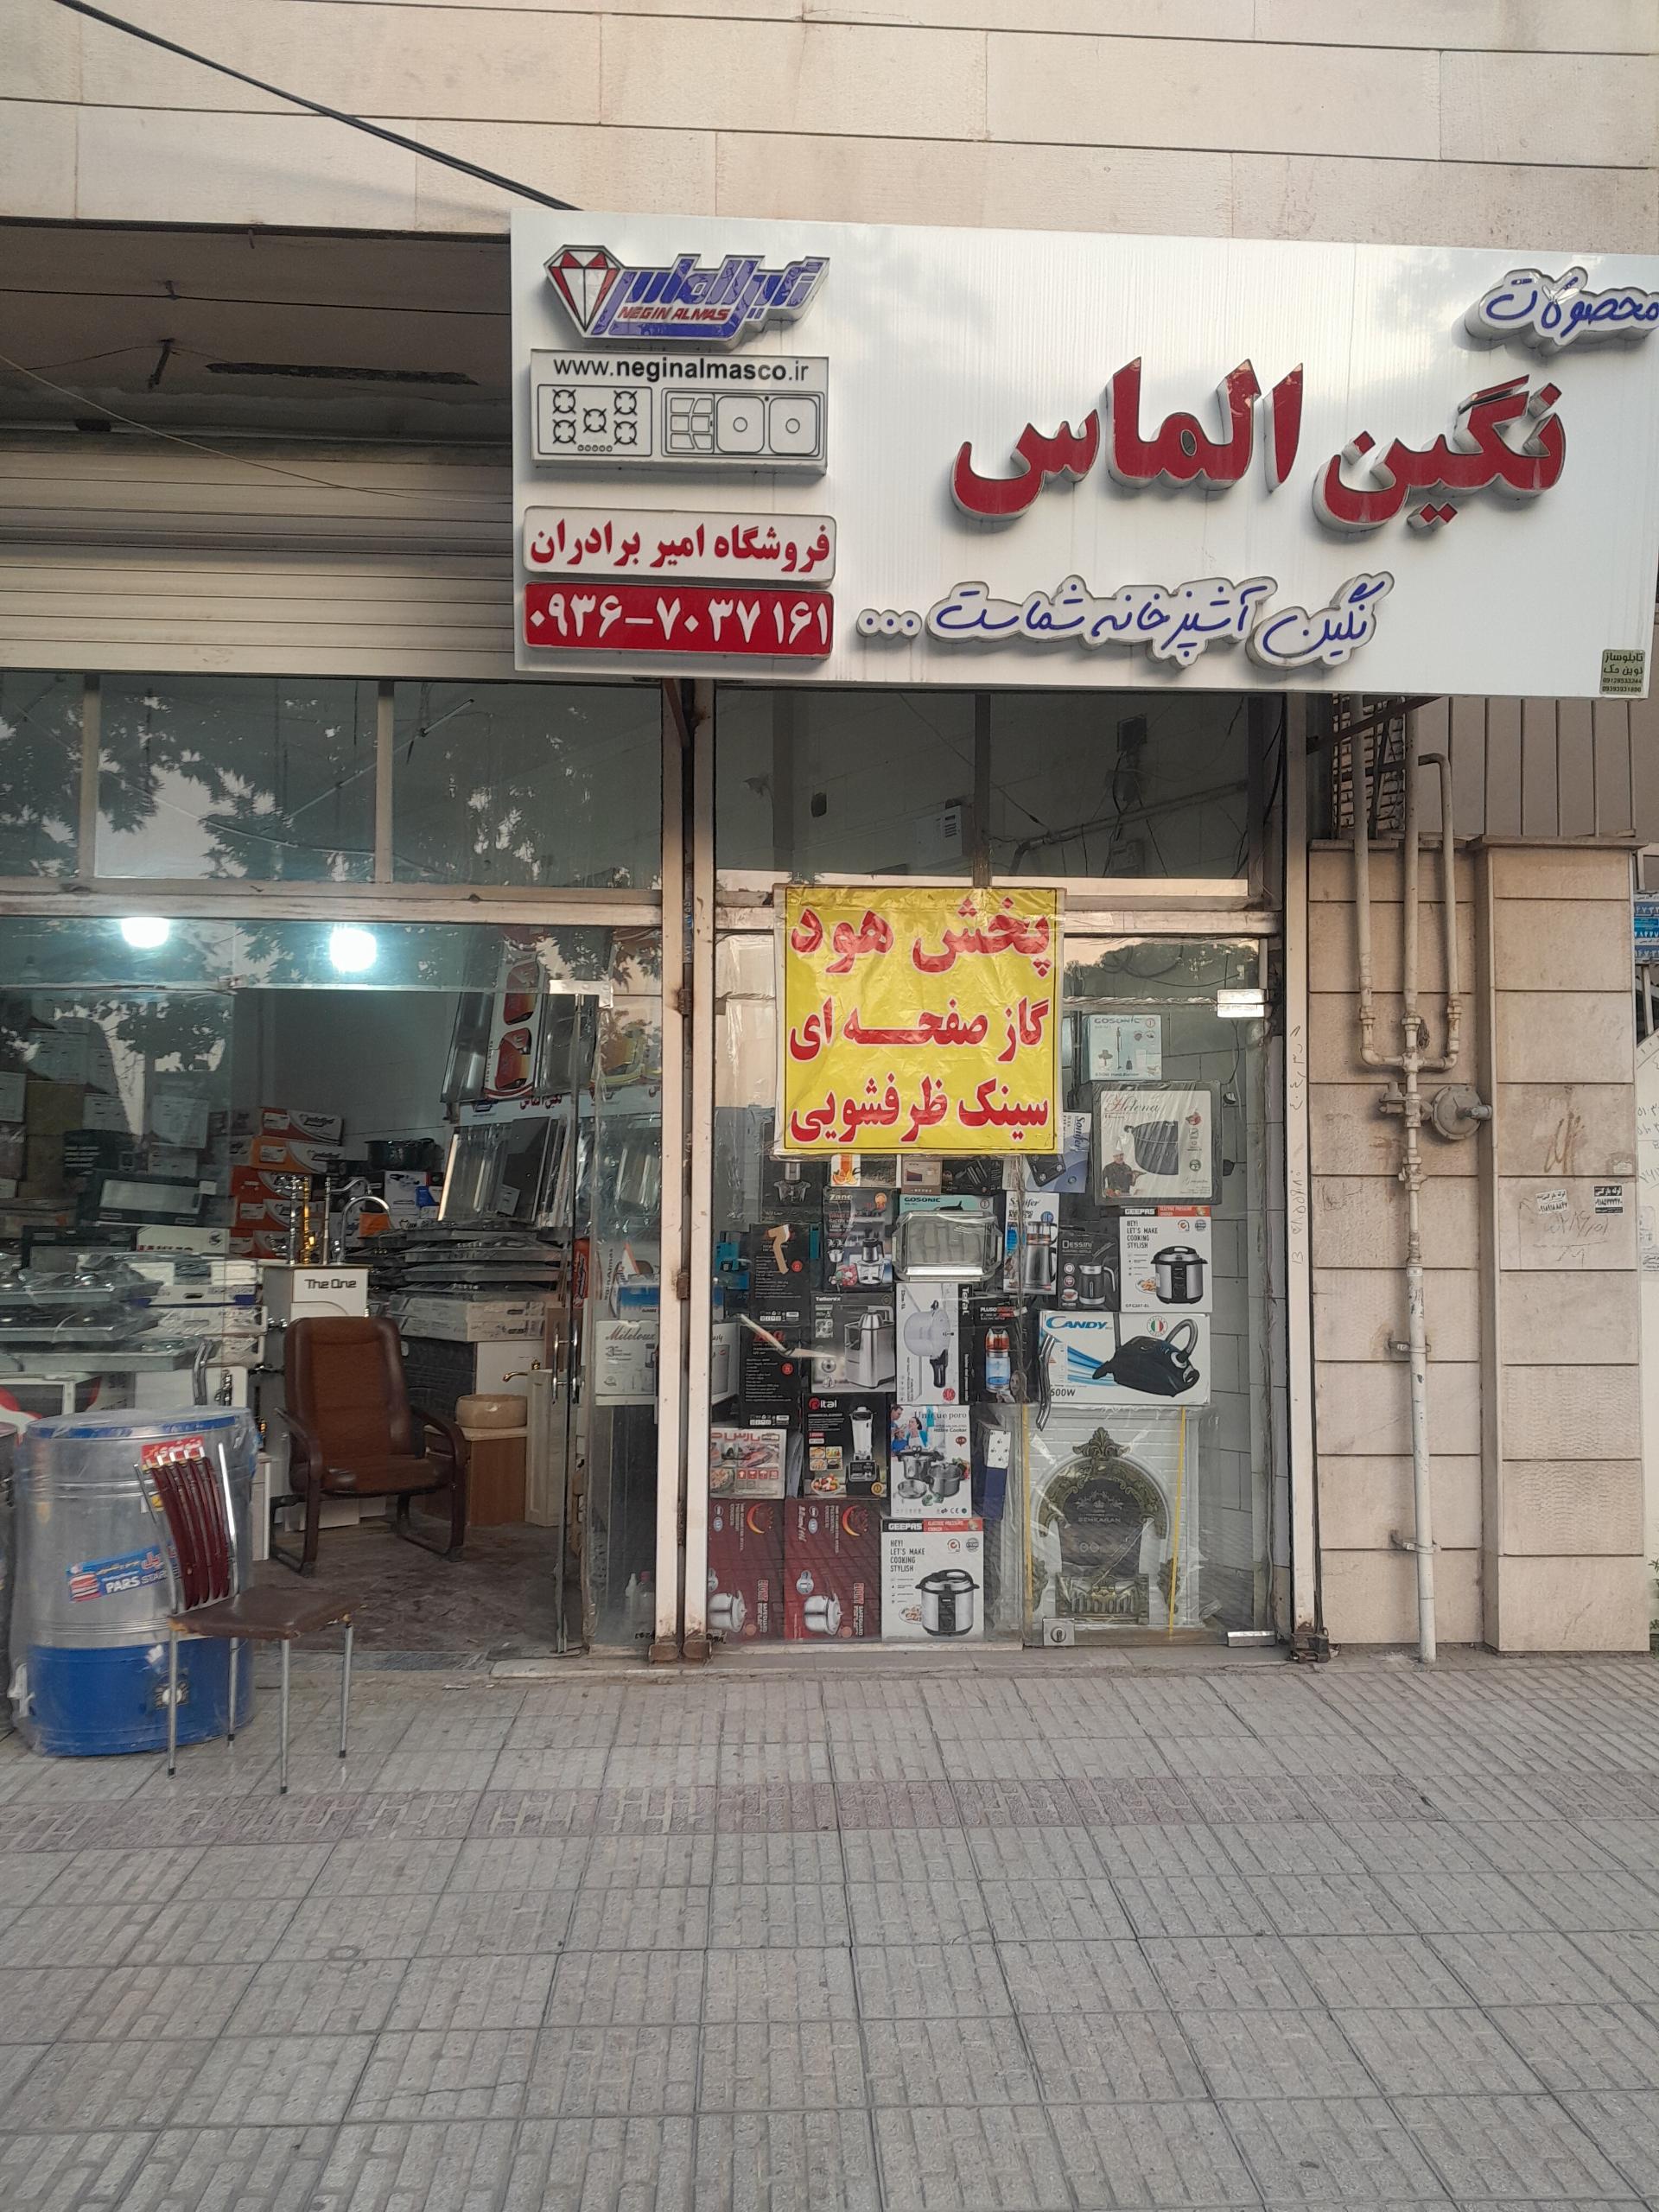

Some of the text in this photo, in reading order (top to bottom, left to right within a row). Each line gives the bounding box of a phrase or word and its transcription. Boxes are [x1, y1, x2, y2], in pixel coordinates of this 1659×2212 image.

[617, 306, 730, 321] NEGIN ALMAS
[554, 357, 809, 381] www.neginalmasco.ir
[952, 355, 1567, 525] نگین الماس
[531, 518, 830, 572] فروشگاه امیر برادران
[937, 583, 1085, 631] شماست
[1093, 585, 1270, 665] آشپزخانه
[1263, 583, 1386, 659] نگین
[1605, 652, 1643, 663] تابلوساز
[791, 897, 1051, 977] پخش هود
[790, 996, 1050, 1062] گاز صفحه ای
[958, 1078, 1048, 1141] سینک
[1009, 1198, 1040, 1208] Sifer
[304, 1278, 357, 1289] The One
[1046, 1315, 1108, 1329] CANDY
[105, 1575, 141, 1594] PARS
